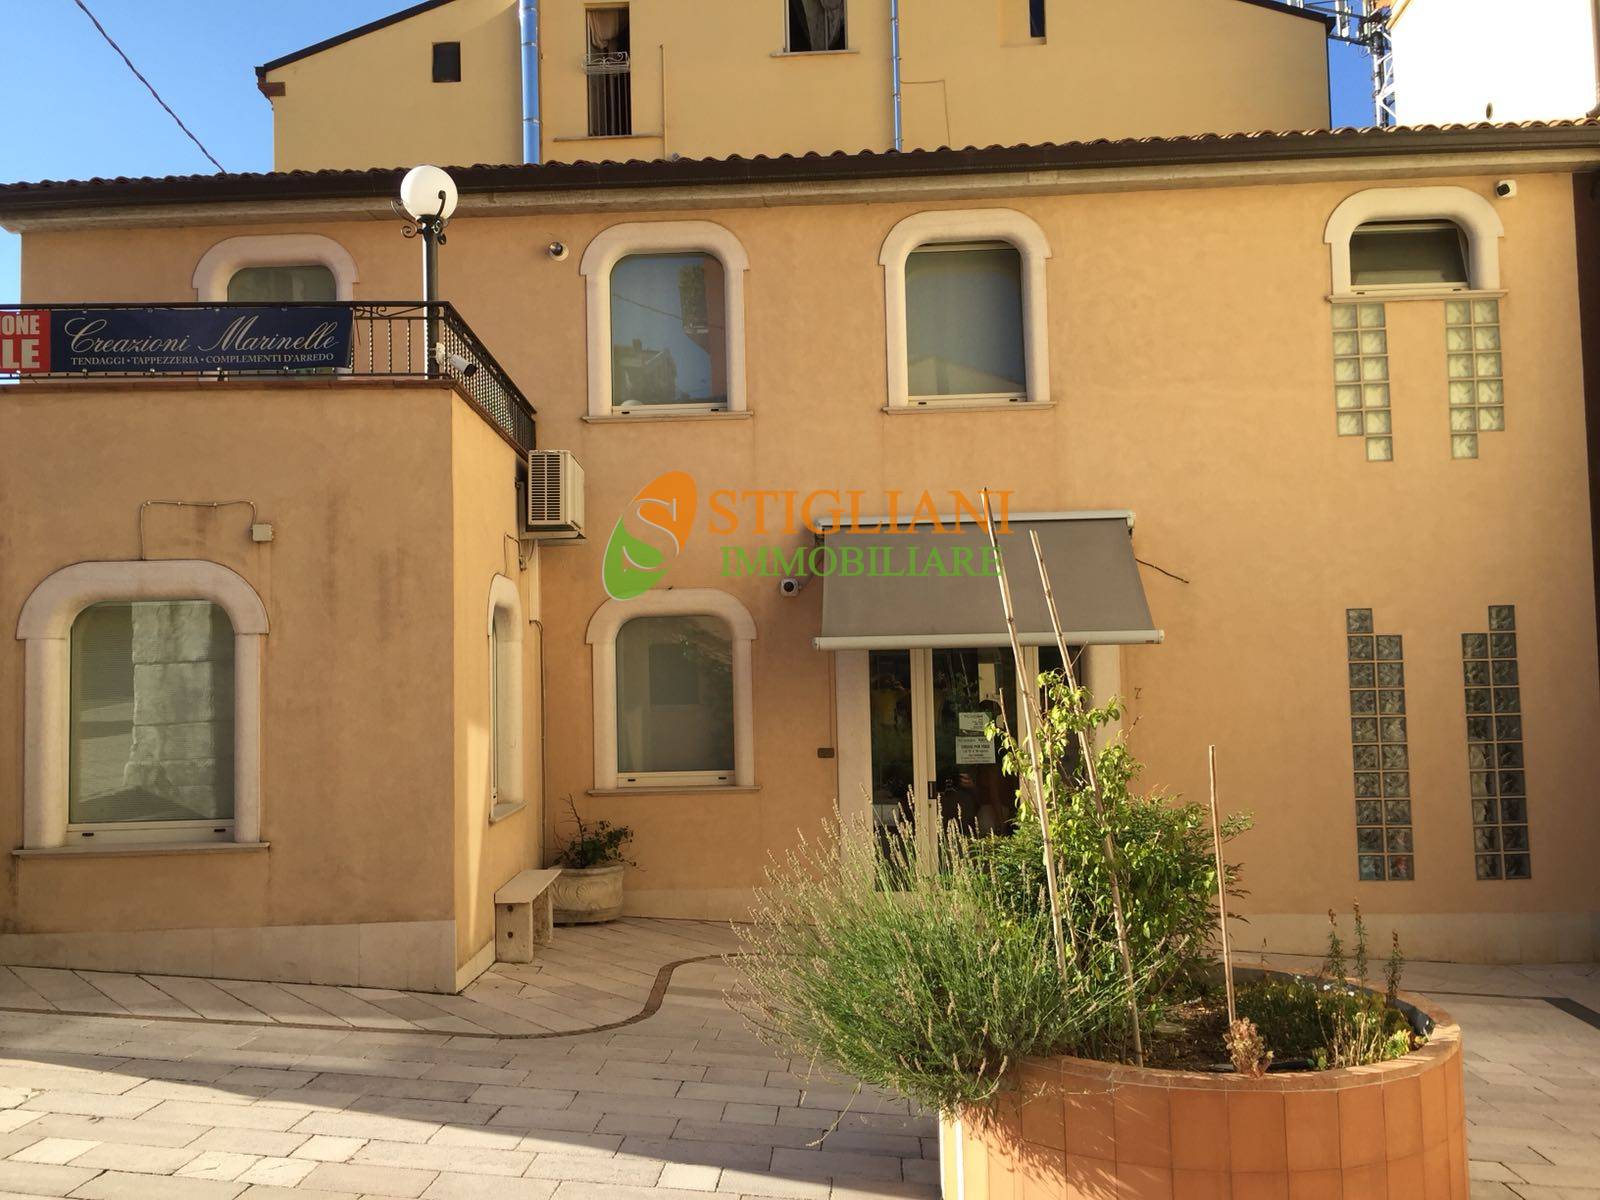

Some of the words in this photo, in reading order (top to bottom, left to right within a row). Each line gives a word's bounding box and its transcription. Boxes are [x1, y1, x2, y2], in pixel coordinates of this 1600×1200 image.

[0, 315, 40, 335] ONE
[64, 317, 191, 353] Creazioni
[198, 315, 339, 351] Marinelle
[0, 338, 40, 368] LE
[70, 356, 125, 365] TENDAGGI
[131, 355, 199, 365] TAPPEZZERIA
[205, 353, 282, 364] COMPLEMENTI
[284, 352, 335, 362] D'ARREDO
